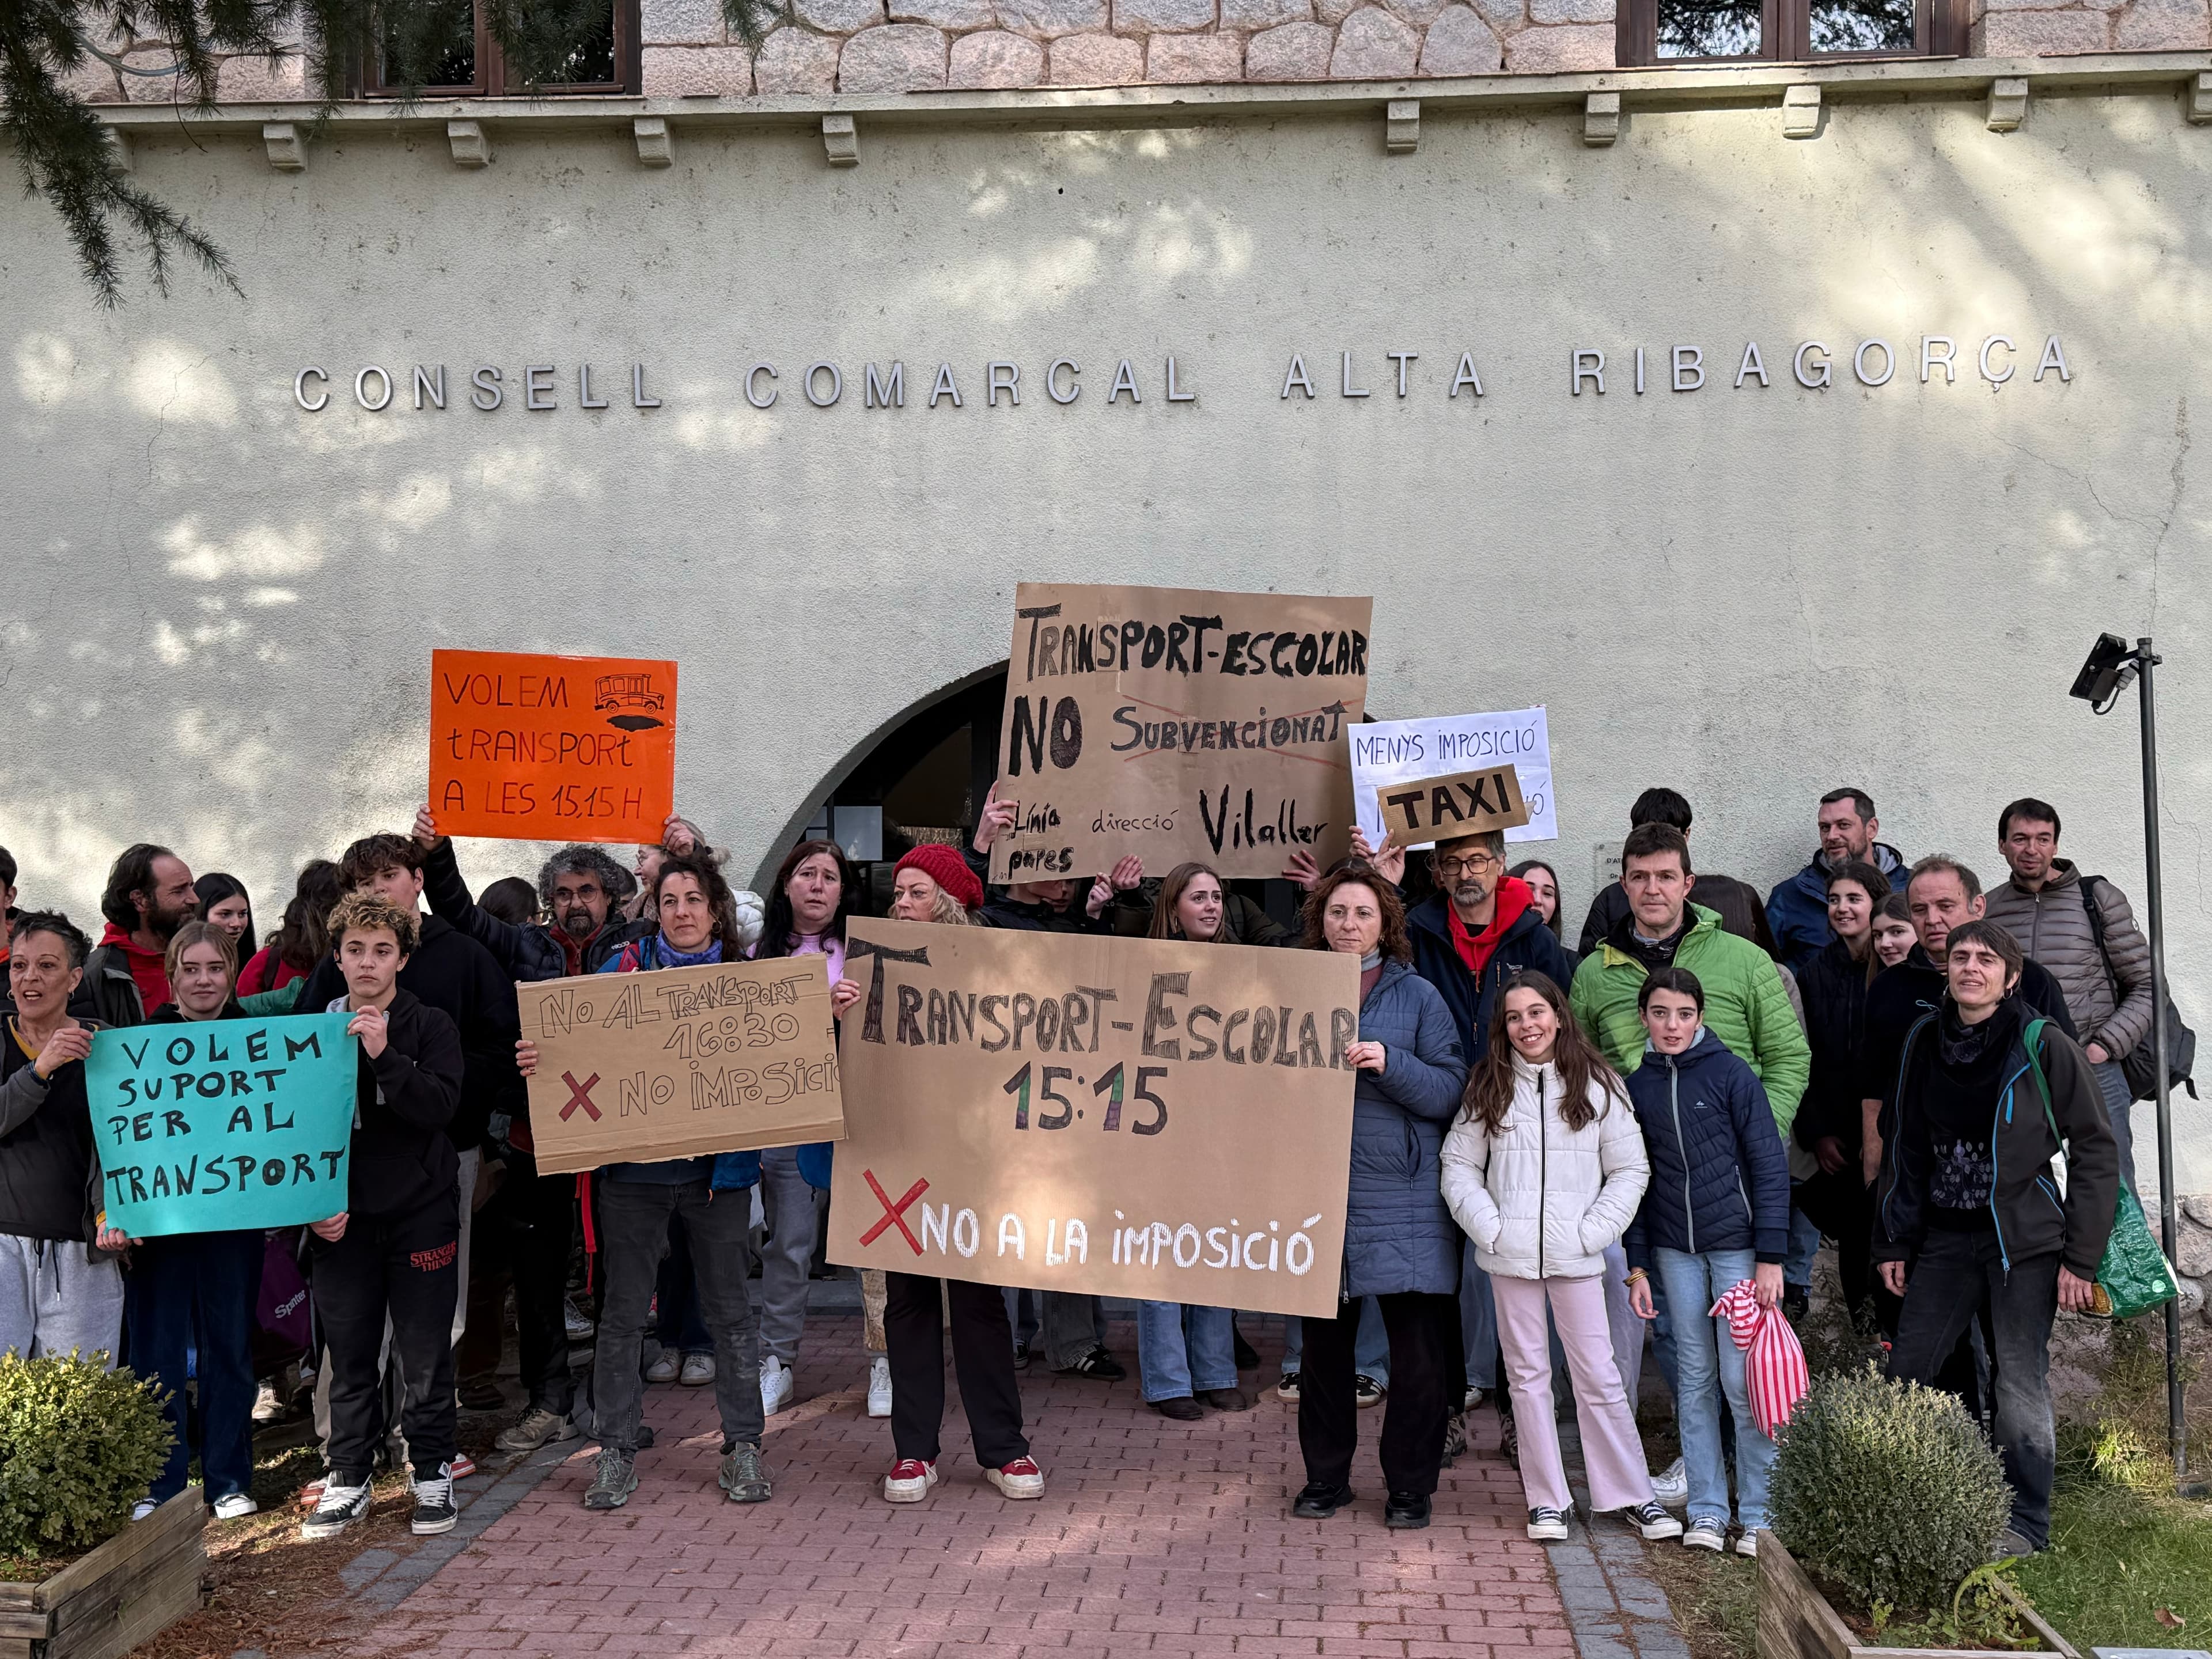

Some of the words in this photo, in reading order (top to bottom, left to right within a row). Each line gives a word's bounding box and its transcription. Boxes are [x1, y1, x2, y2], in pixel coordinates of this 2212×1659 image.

[294, 363, 662, 411] CONSELL
[745, 355, 1195, 408] COMARCAL
[1281, 351, 1485, 399] ALTA
[1571, 335, 2071, 396] RIBAGORÇA
[444, 673, 569, 707] VOLEM
[1008, 695, 1082, 776] NO
[1357, 734, 1424, 766] MENYS
[444, 780, 464, 811] A
[486, 782, 536, 815] LES
[1092, 809, 1179, 834] direcció
[1199, 785, 1328, 855] Vilaller
[1387, 774, 1512, 829] TAXI
[1009, 847, 1074, 880] pares
[603, 984, 661, 1028] AL
[657, 974, 813, 1020] TRANSPORT
[121, 1028, 322, 1069] VOLEM
[663, 1013, 800, 1059] 16:30
[118, 1069, 287, 1107] SUPORT
[619, 1071, 675, 1116] NO
[1003, 1060, 1168, 1136] 15:15
[107, 1110, 191, 1145] PER
[228, 1102, 294, 1133] AL
[106, 1145, 346, 1205] TRANSPORT
[410, 1240, 456, 1266] STRANGER
[921, 1201, 980, 1258] NO
[997, 1212, 1025, 1260] A
[1046, 1217, 1088, 1266] LA
[421, 1256, 452, 1272] THINGS
